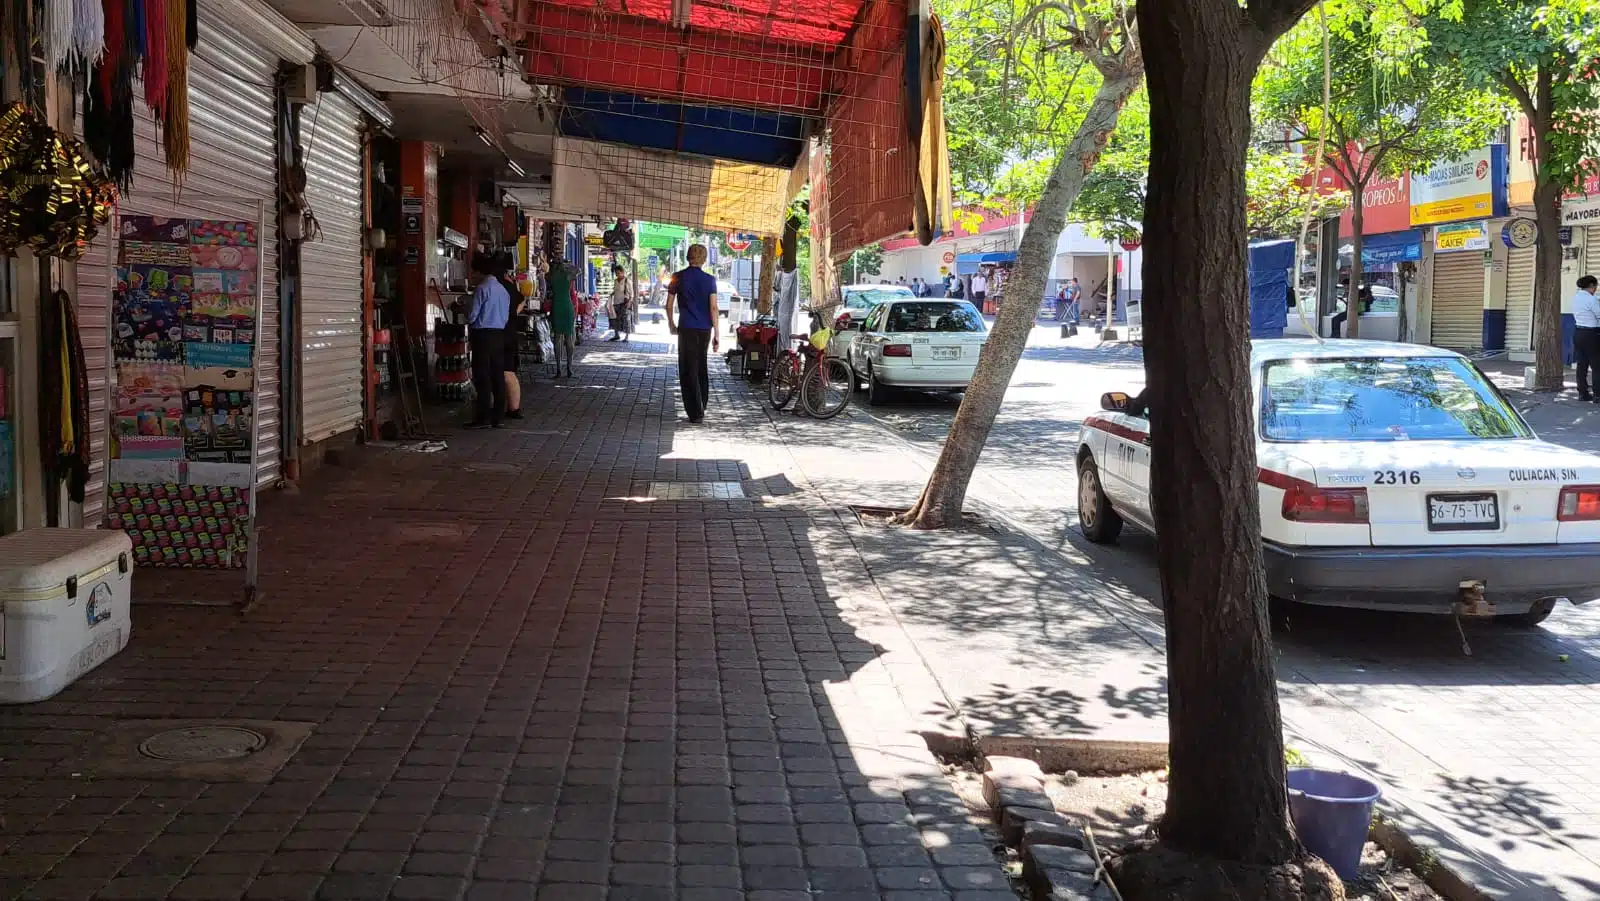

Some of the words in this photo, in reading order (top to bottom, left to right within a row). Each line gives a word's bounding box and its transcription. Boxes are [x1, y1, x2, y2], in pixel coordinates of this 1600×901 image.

[1566, 208, 1600, 221] MAYORE
[1373, 470, 1421, 485] 2316
[1508, 468, 1559, 483] CULIACAN,
[1561, 468, 1580, 481] SIN.
